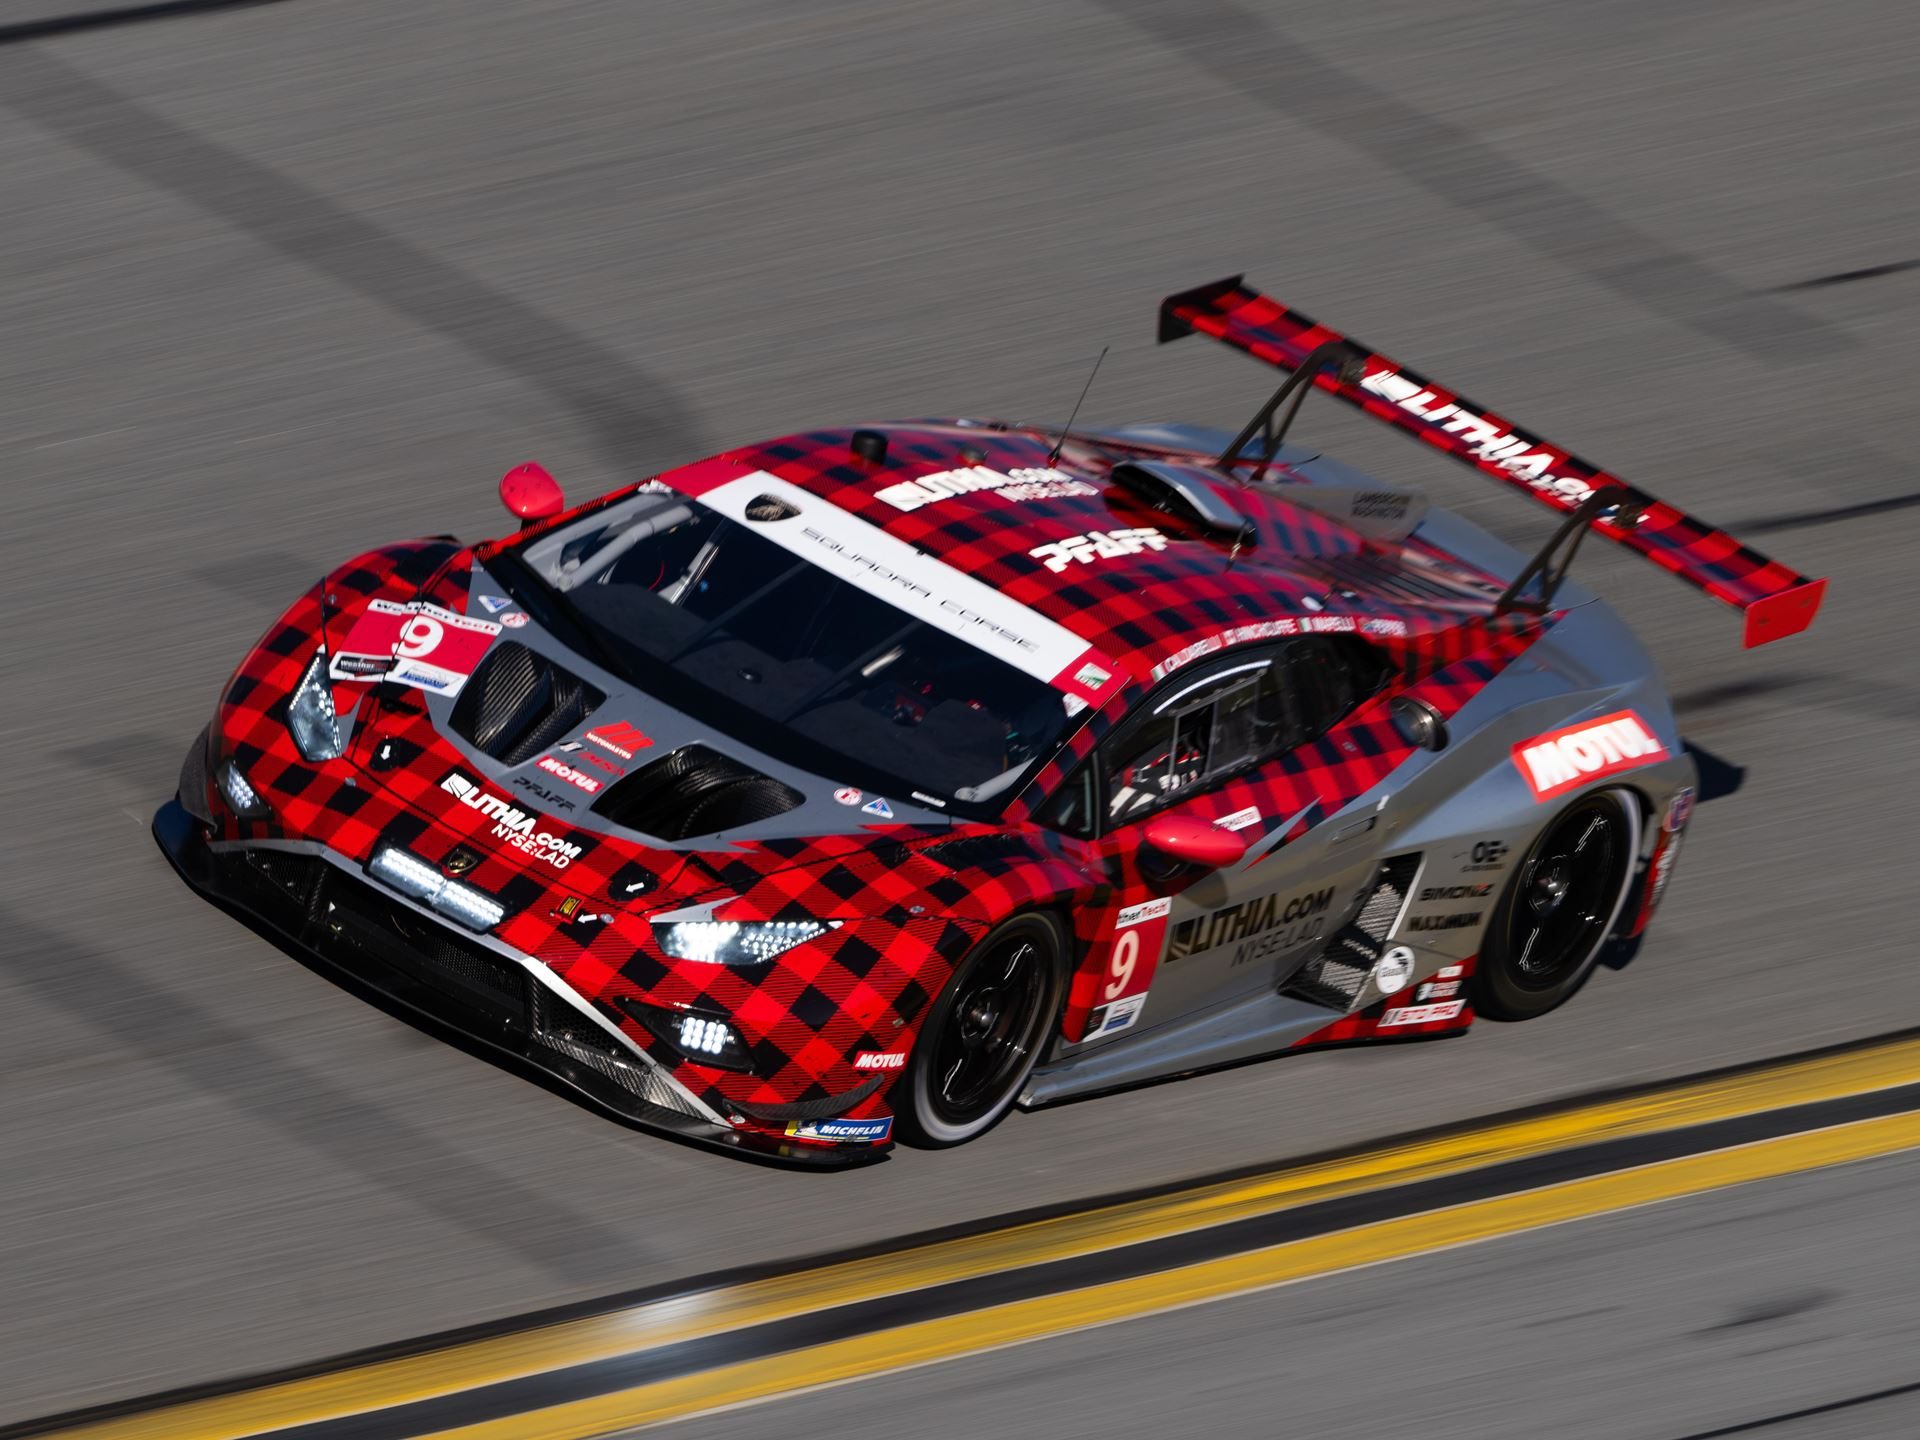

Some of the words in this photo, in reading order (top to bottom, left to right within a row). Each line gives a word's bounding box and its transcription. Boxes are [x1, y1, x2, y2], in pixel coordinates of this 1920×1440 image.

[391, 615, 444, 658] 9
[940, 600, 1041, 654] CORSE
[539, 758, 599, 793] MOTUL
[1522, 717, 1664, 792] MOTUL
[513, 776, 576, 813] PFAFF
[460, 786, 583, 861] LITHIA.COM
[491, 823, 571, 870] NYSE:LAD
[1187, 886, 1336, 955] LITHIA.COM
[1104, 930, 1139, 1000] 9
[855, 1053, 905, 1068] MOTUL
[820, 1125, 885, 1136] MICHELIN
